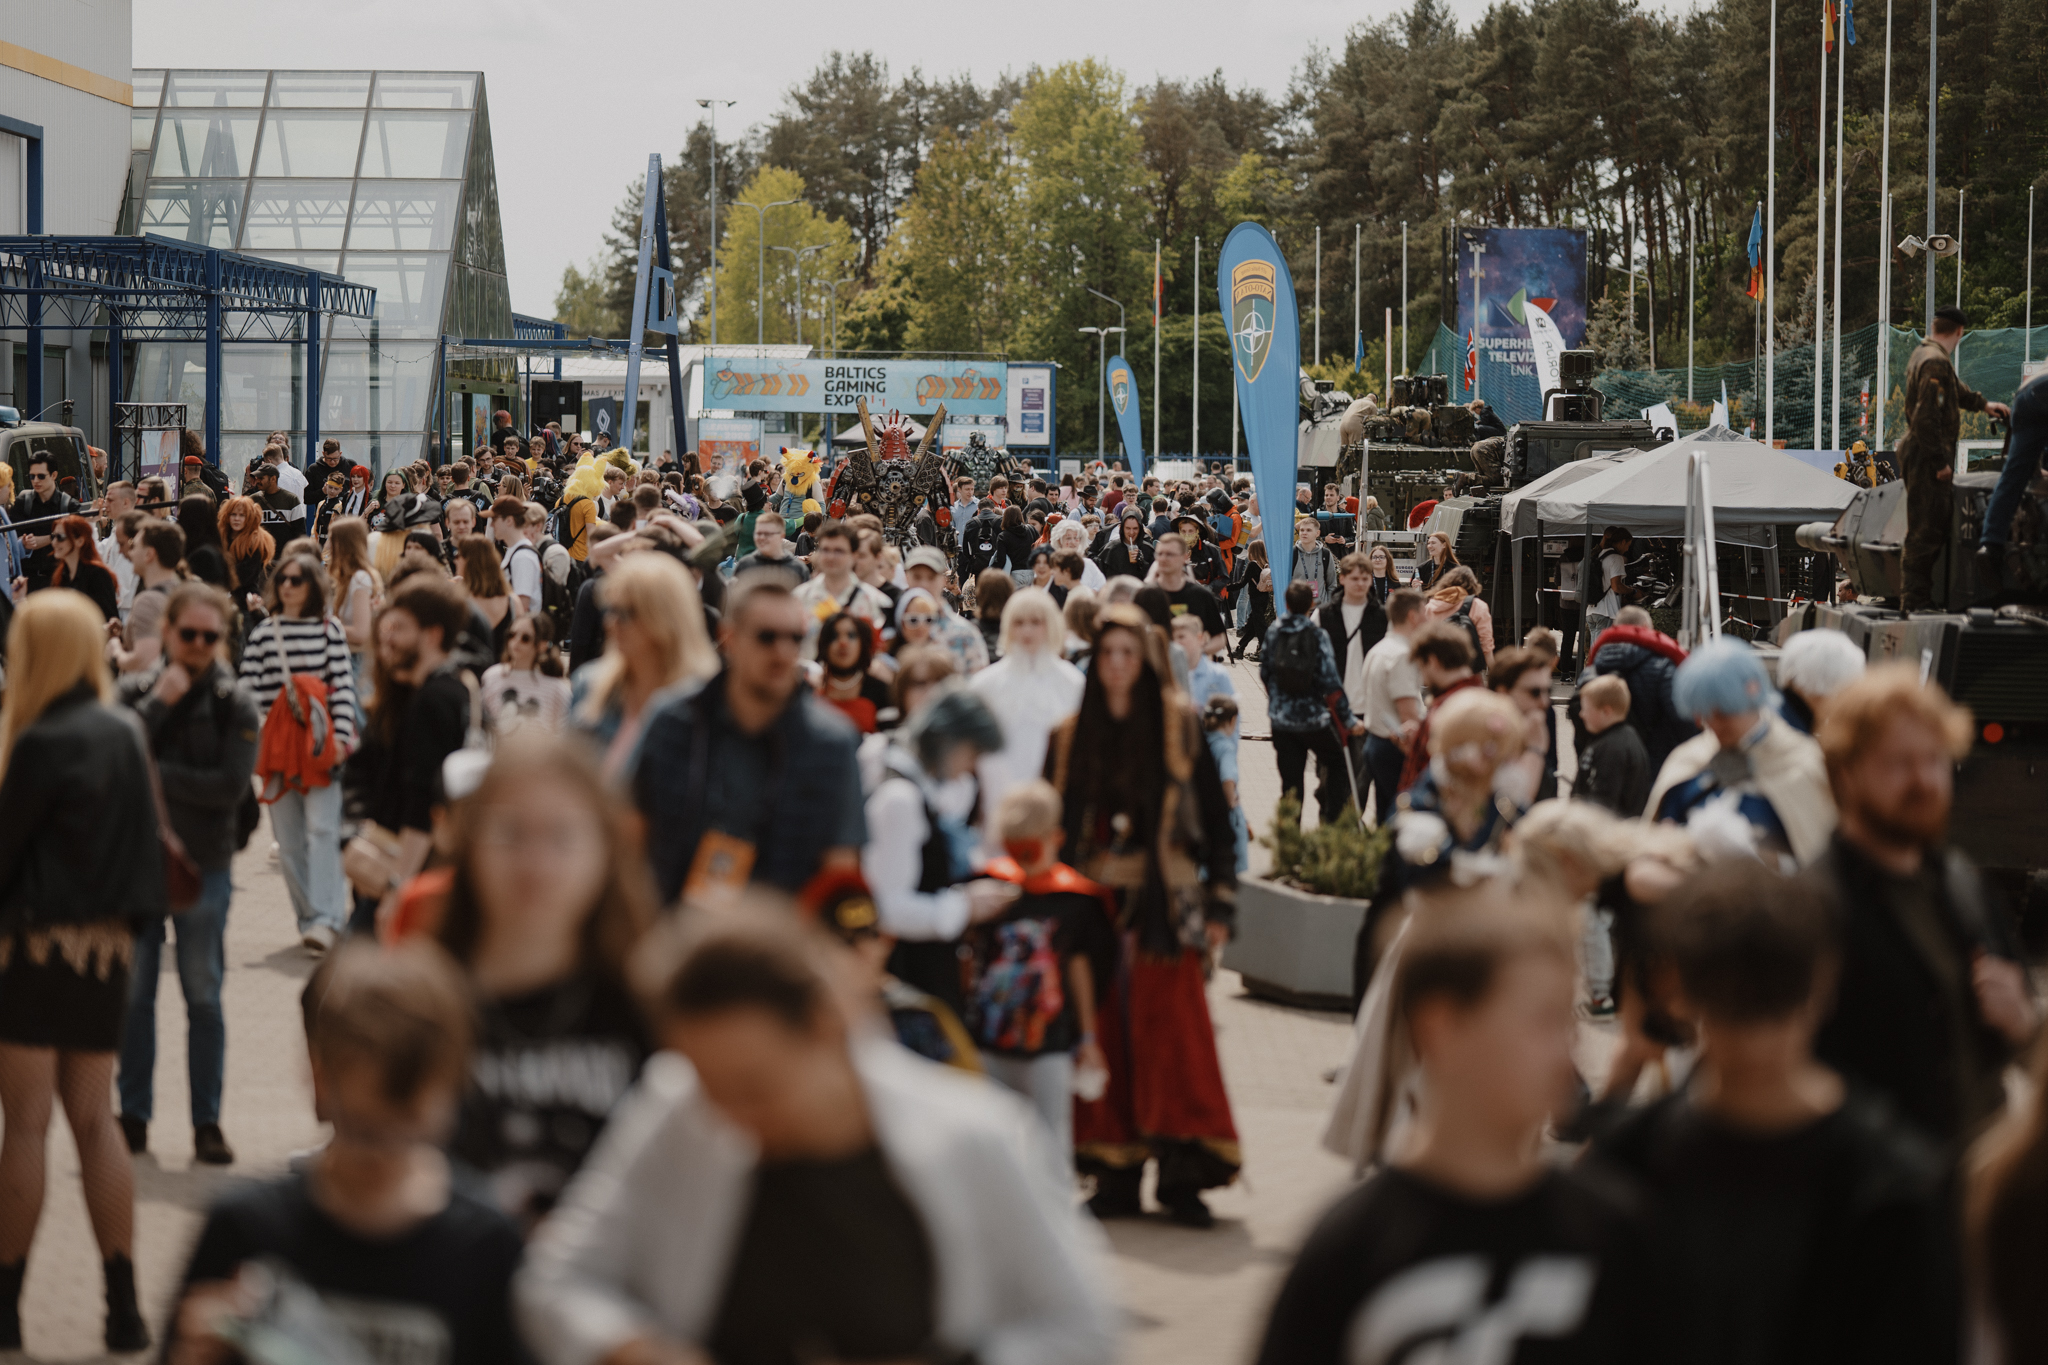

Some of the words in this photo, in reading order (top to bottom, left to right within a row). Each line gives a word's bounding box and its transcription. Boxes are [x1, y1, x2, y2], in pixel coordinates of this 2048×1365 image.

[1479, 337, 1536, 349] SUPERHE
[1488, 351, 1537, 363] TELEVIZ
[825, 366, 887, 379] BALTICS
[1510, 364, 1534, 376] LNK
[824, 380, 887, 393] GAMING
